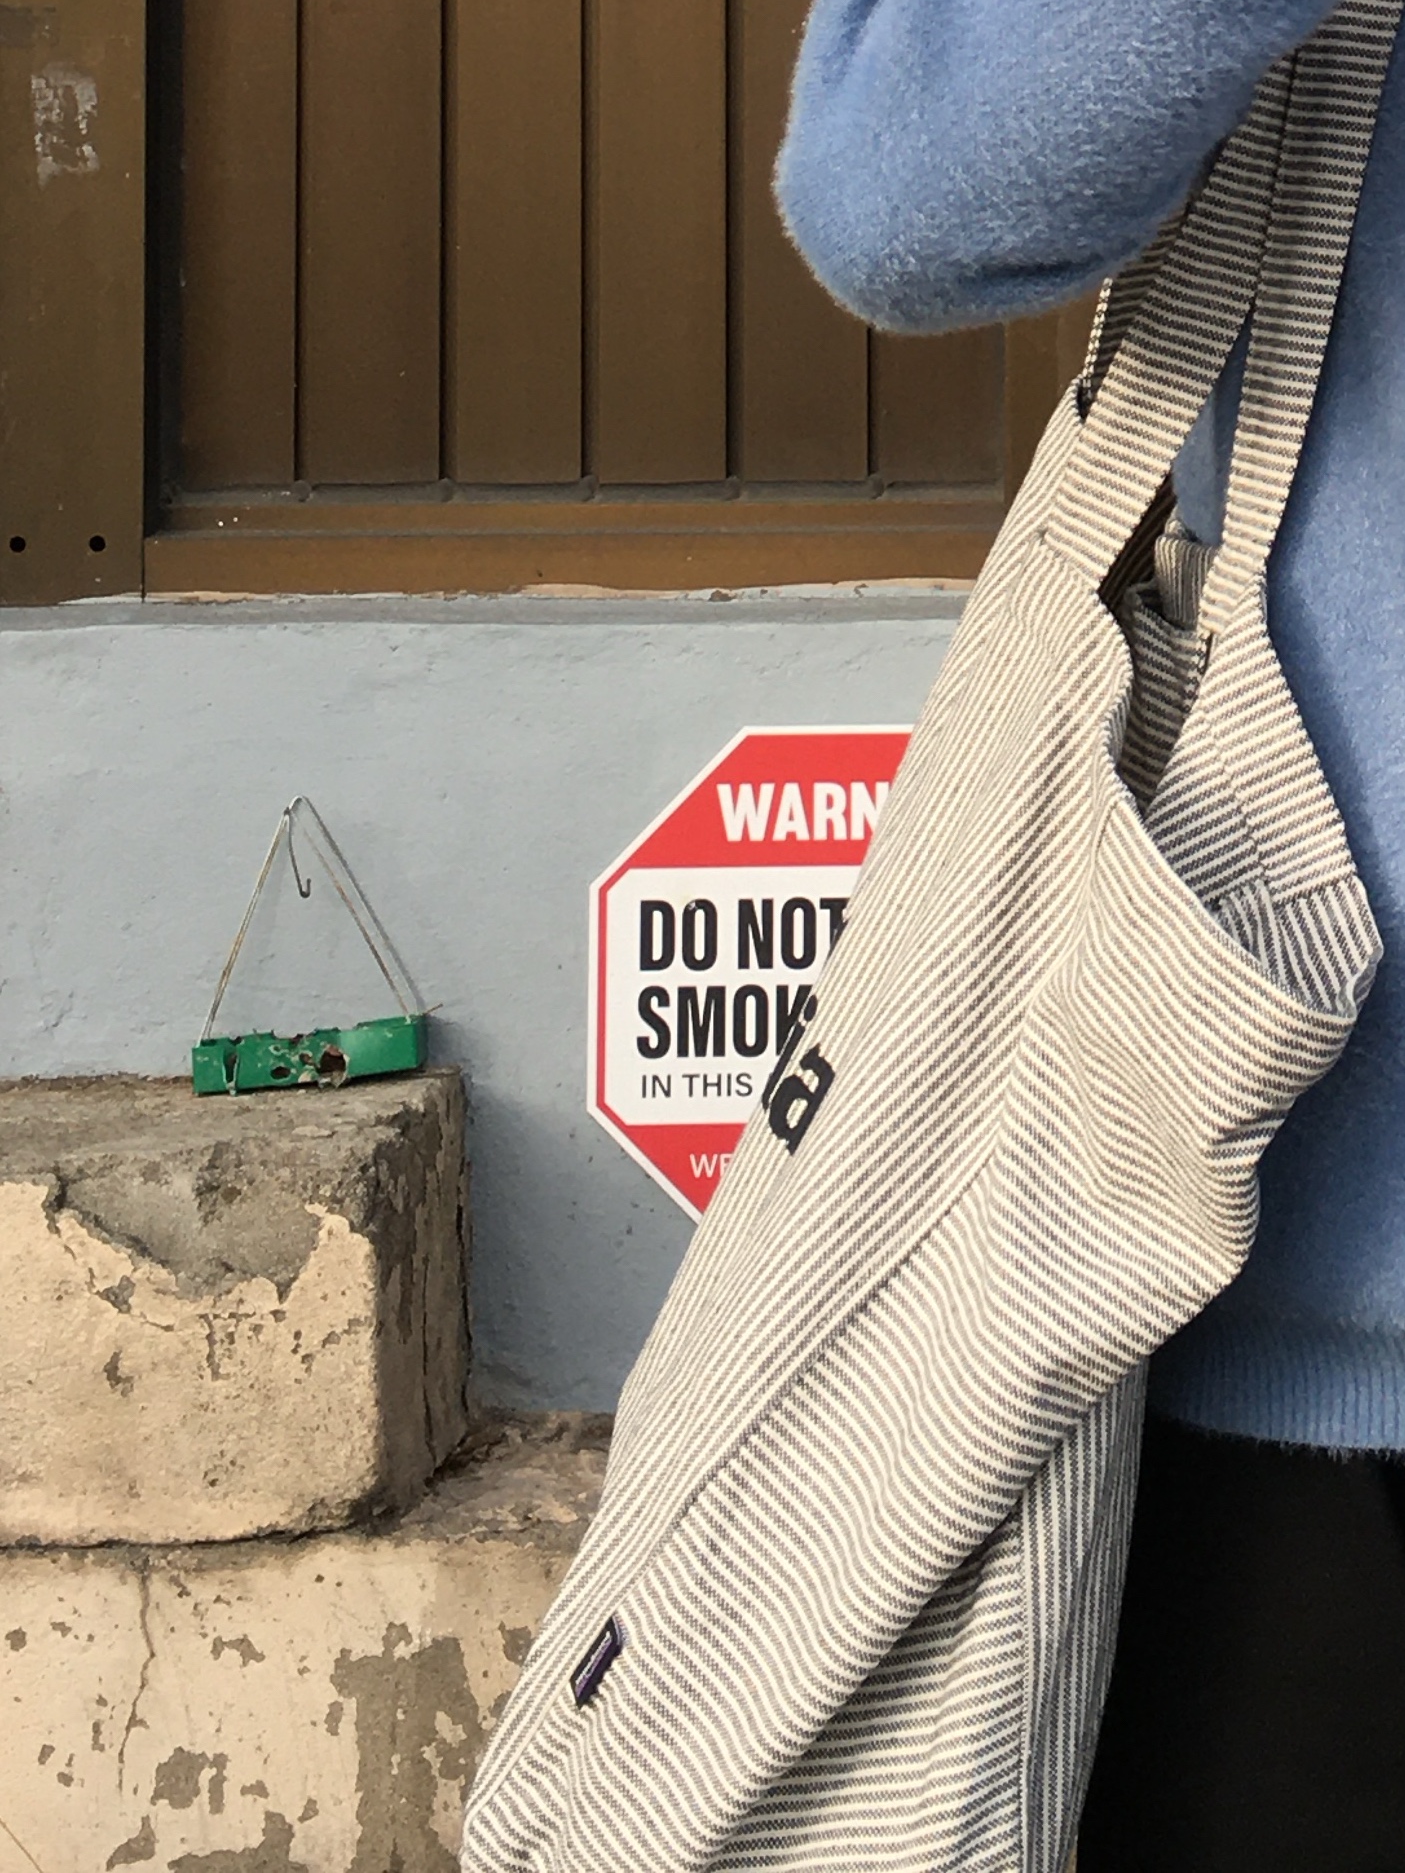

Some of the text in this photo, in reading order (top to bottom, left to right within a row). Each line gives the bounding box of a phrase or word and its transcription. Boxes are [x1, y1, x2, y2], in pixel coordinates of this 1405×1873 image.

[716, 781, 890, 843] WARN
[638, 897, 718, 972] DO
[636, 984, 814, 1059] SMOK
[641, 1072, 753, 1099] IN THIS
